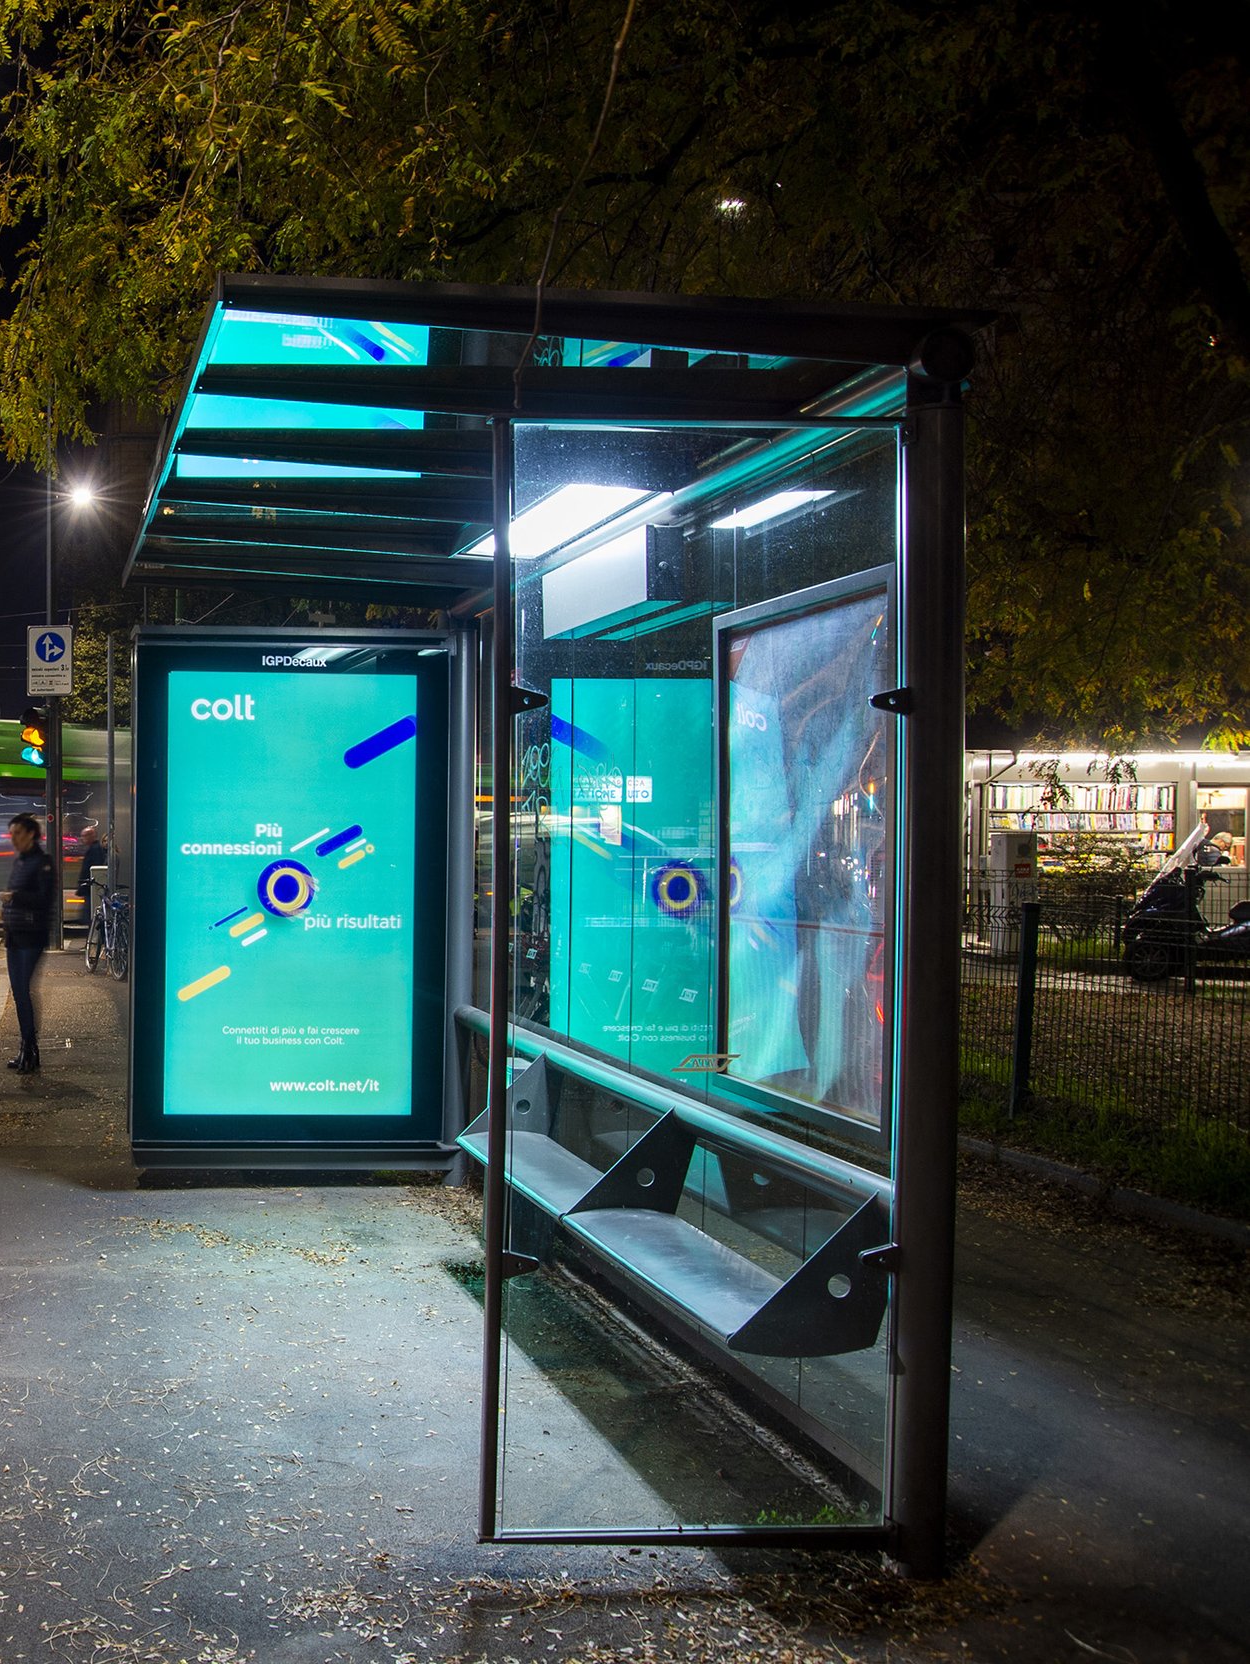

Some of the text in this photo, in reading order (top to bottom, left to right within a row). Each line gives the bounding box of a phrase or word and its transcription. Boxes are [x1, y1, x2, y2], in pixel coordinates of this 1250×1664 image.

[262, 655, 327, 667] IGPDecaux
[191, 694, 255, 721] colt
[255, 823, 283, 838] Più
[180, 841, 283, 856] connessioni
[304, 914, 402, 931] più risultati
[222, 1025, 269, 1035] Connettiti
[271, 1026, 280, 1035] di
[282, 1026, 297, 1037] più
[307, 1026, 319, 1035] fai
[321, 1027, 360, 1035] crescere
[237, 1036, 242, 1045] il
[244, 1037, 261, 1045] tuo
[262, 1036, 302, 1045] business
[323, 1036, 345, 1045] Colt.
[270, 1078, 380, 1093] www.colt.net/it
